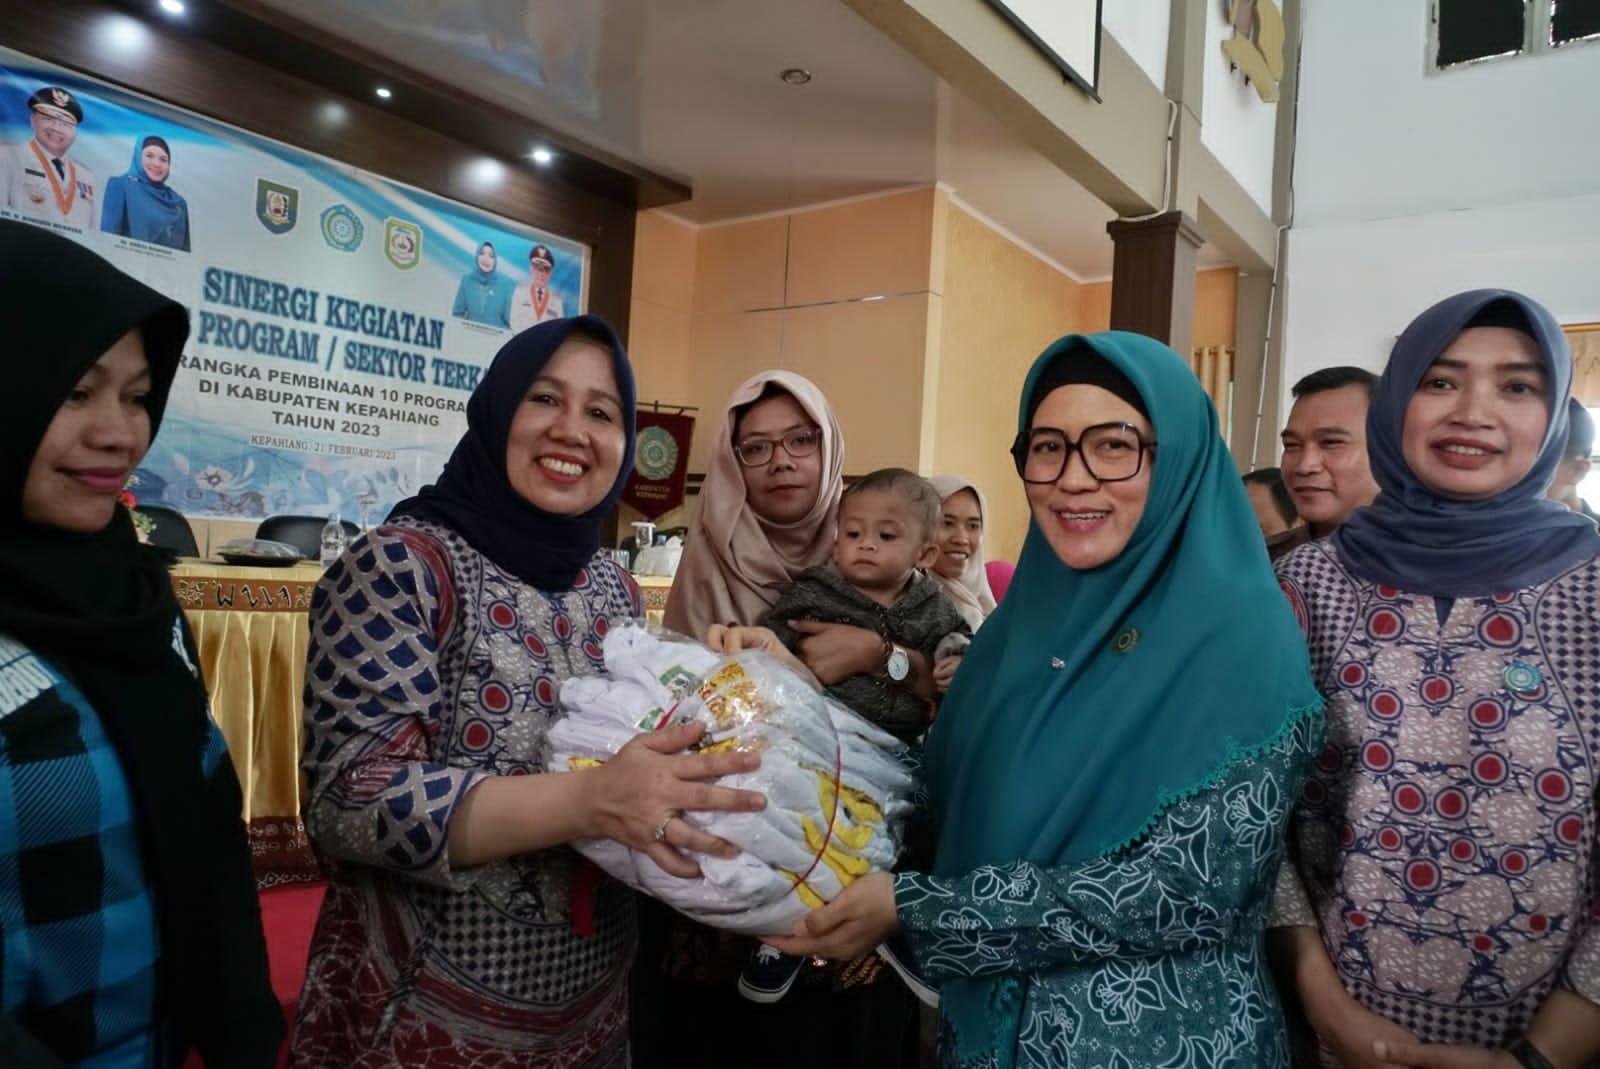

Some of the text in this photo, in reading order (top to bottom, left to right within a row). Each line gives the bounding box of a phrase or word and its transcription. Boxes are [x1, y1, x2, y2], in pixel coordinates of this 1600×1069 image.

[203, 266, 444, 349] SINERGI KEGIATAN
[198, 310, 489, 391] PROGRAM / SEKTOR TERK
[180, 354, 466, 413] RANGKA PEMBINAAN 10 PROGRA
[199, 379, 440, 427] DI KABUPATEN KEPAHIANG
[272, 411, 381, 437] TAHUN 2023
[329, 444, 373, 458] FEBRUARI
